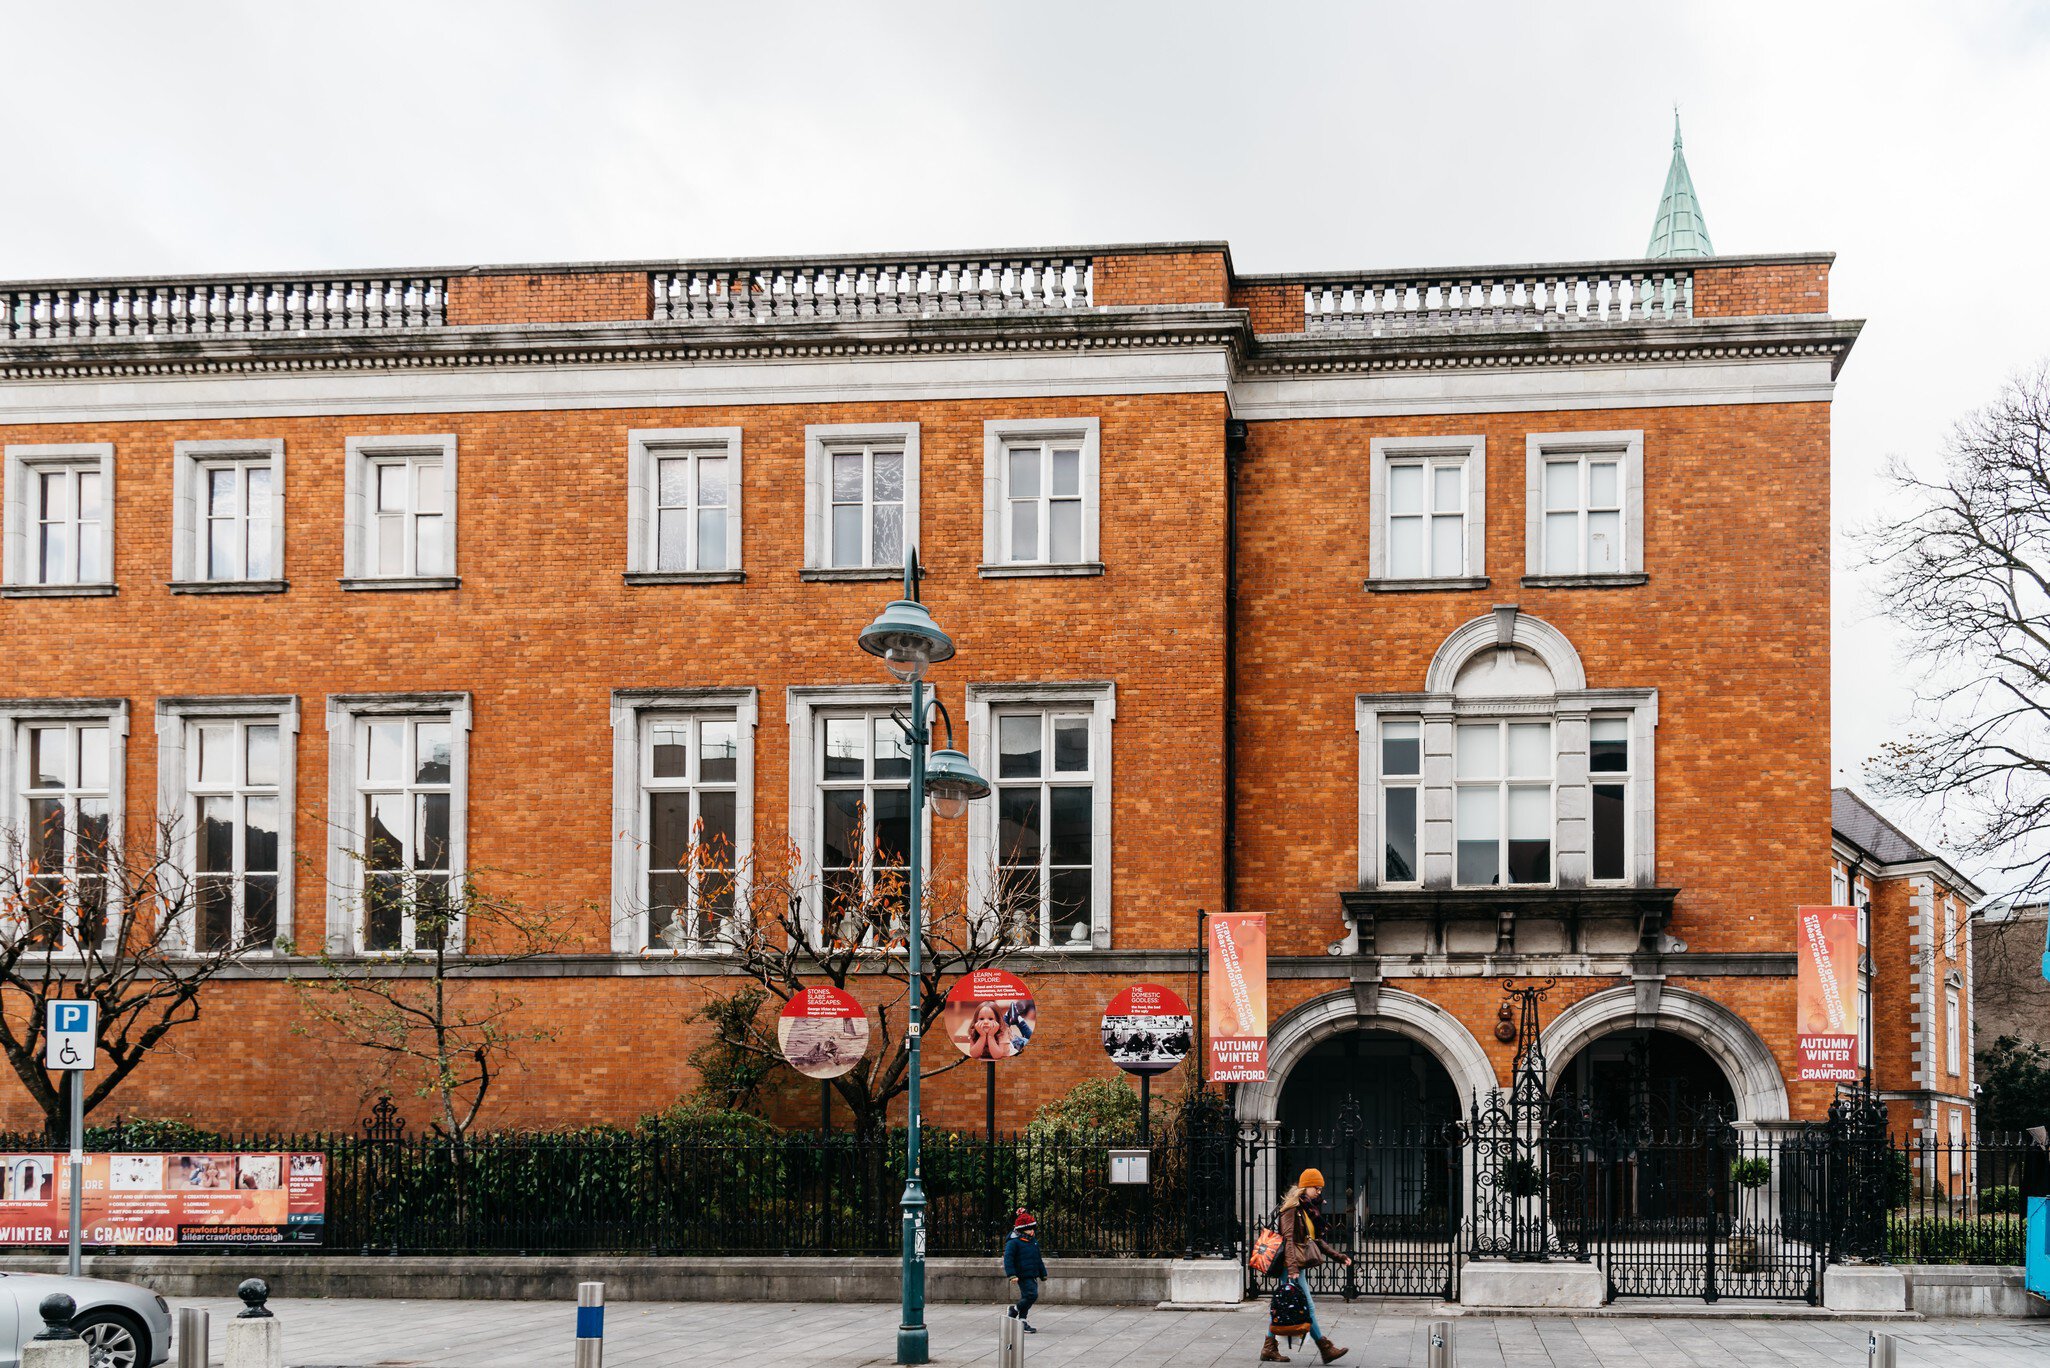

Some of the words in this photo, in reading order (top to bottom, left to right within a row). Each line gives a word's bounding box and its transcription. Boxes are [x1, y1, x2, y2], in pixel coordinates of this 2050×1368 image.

[1811, 913, 1829, 955] crawford
[1221, 921, 1239, 961] crawford
[1221, 948, 1238, 988] crawford
[1232, 960, 1242, 973] art
[1811, 942, 1828, 983] crawford
[1822, 955, 1832, 968] art
[1235, 973, 1250, 1003] gallery
[1825, 968, 1840, 999] gallery
[1245, 1003, 1256, 1023] cork
[1835, 999, 1846, 1021] cork
[63, 1006, 81, 1030] P
[909, 1025, 919, 1033] 10
[1212, 1040, 1265, 1051] AUTUMN/
[1800, 1038, 1855, 1050] AUTUMN/
[1218, 1052, 1259, 1063] WINTER
[1805, 1050, 1850, 1061] WINTER
[1214, 1070, 1265, 1081] CRAWFORD
[1801, 1068, 1856, 1080] CRAWFORD
[0, 1226, 52, 1241] WINTER
[58, 1230, 69, 1239] AT
[94, 1226, 175, 1242] CRAWFORD
[181, 1226, 218, 1234] crawford
[218, 1226, 230, 1234] art
[230, 1226, 259, 1236] gallery
[259, 1226, 278, 1234] cork
[205, 1233, 242, 1241] crawford
[242, 1233, 284, 1243] chorcaigh
